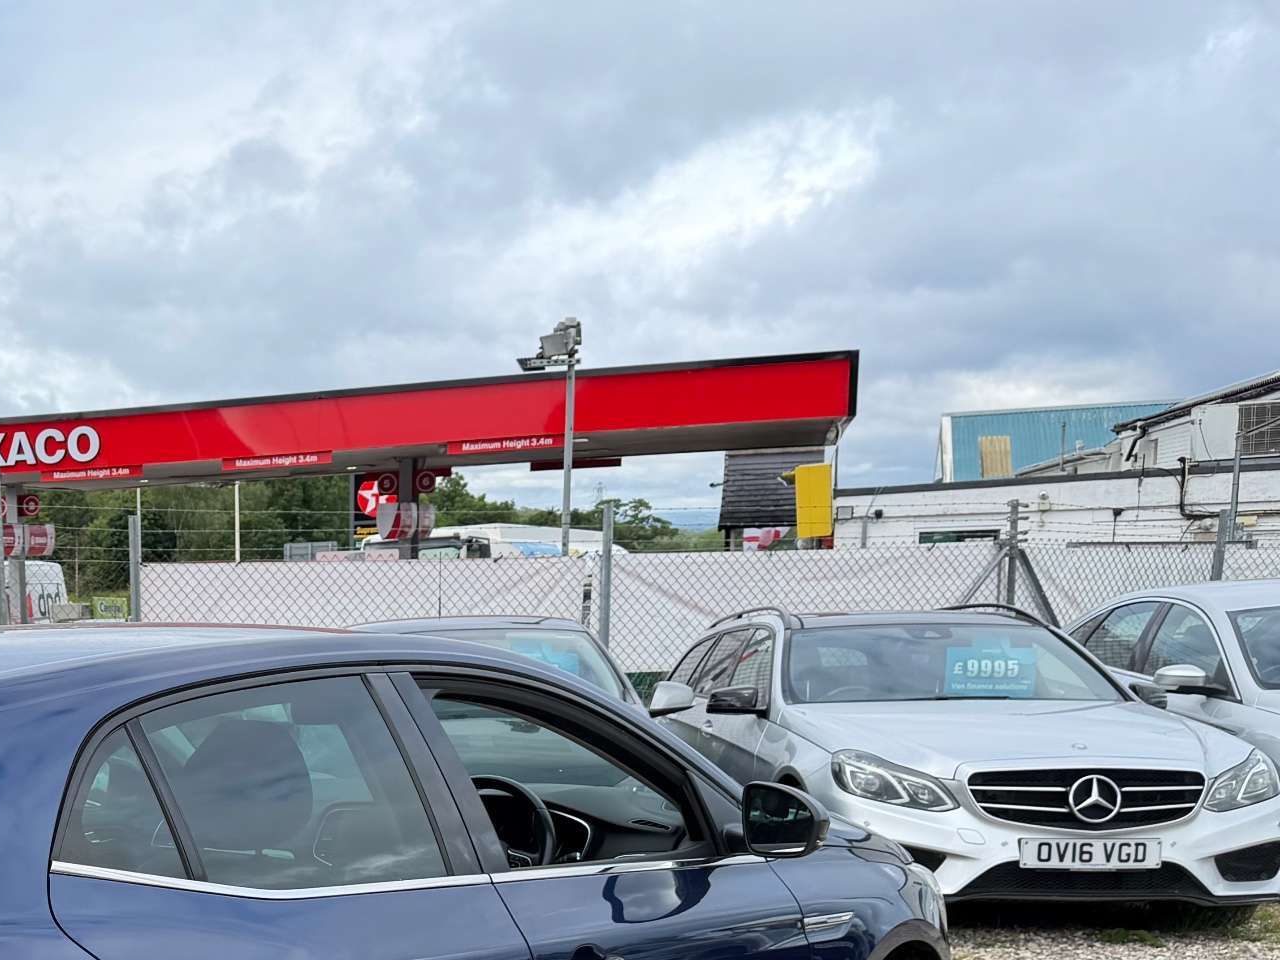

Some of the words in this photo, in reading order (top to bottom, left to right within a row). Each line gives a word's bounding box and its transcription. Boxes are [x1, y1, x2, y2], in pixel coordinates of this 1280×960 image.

[462, 442, 501, 451] Maximum
[502, 439, 530, 449] Height
[530, 437, 553, 446] 3.4m
[235, 458, 271, 467] Maximum
[272, 456, 297, 466] Height
[298, 454, 318, 463] 3.4m
[53, 470, 86, 479] Maximum
[87, 468, 110, 478] Height
[111, 467, 130, 476] 3.4m
[1037, 842, 1094, 863] OV16
[1103, 842, 1147, 863] VGD
